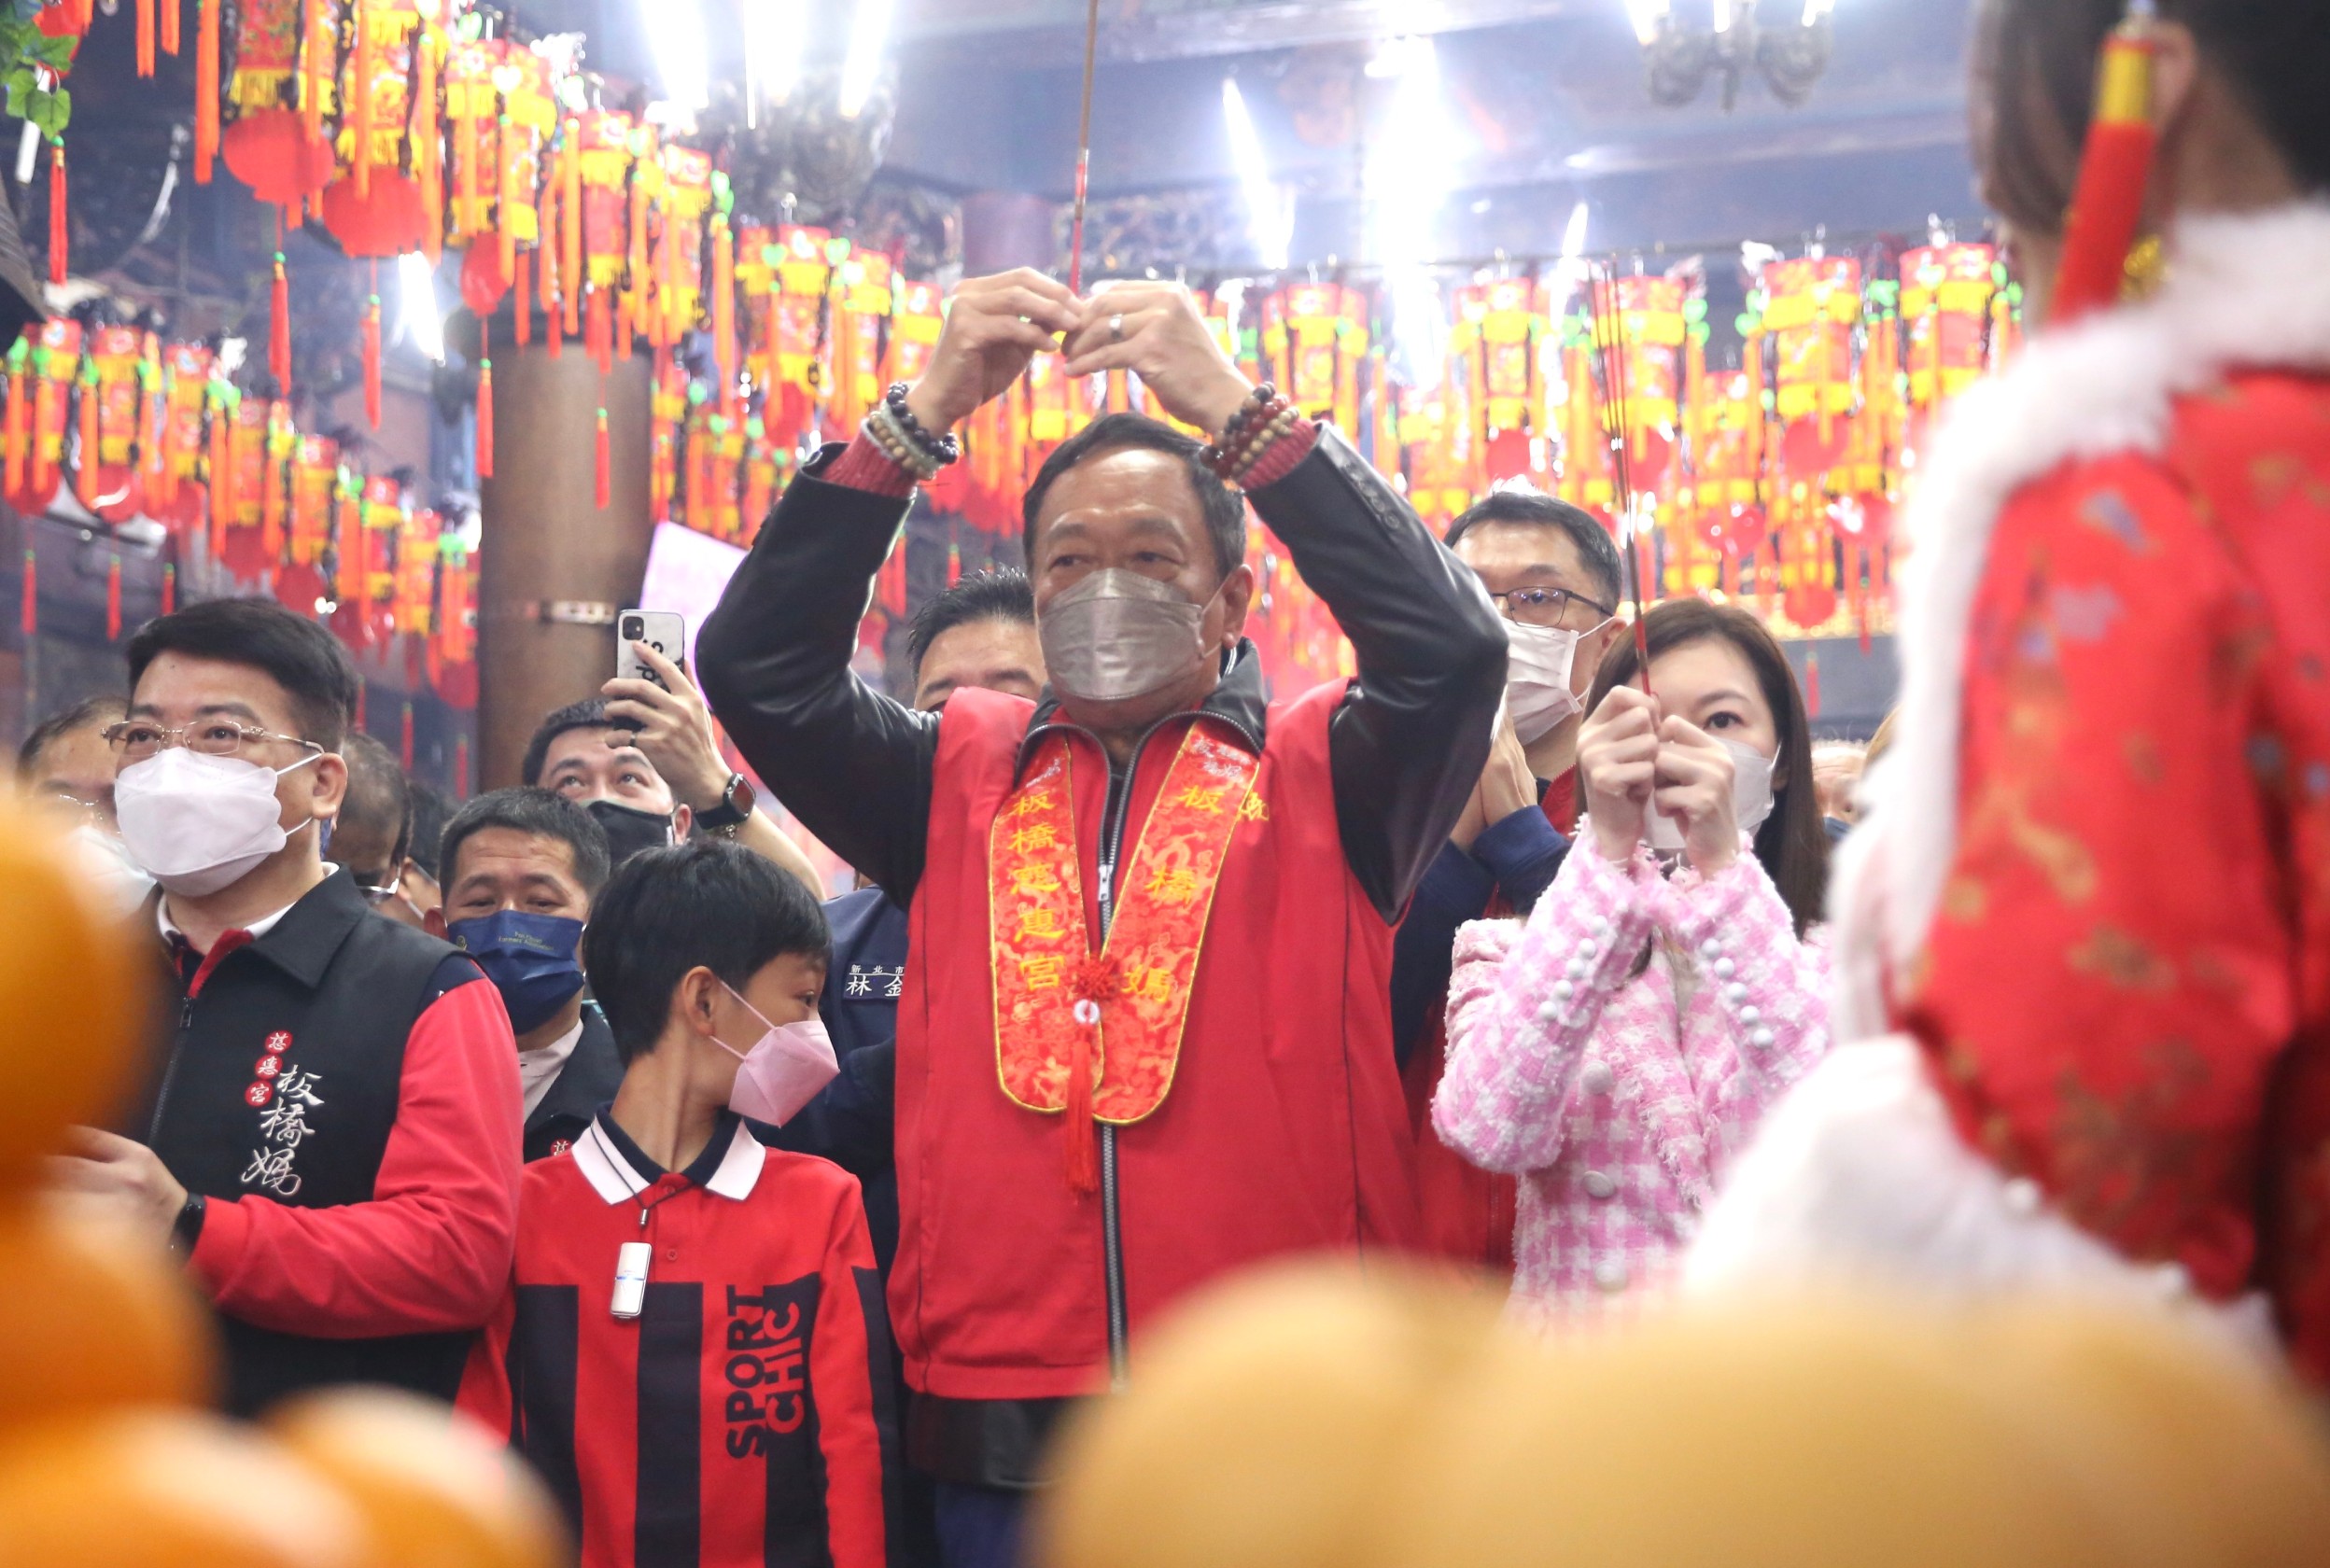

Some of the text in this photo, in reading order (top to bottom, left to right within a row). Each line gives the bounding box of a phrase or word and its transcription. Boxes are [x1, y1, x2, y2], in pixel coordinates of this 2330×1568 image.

[1006, 790, 1066, 992] 板橋慈惠宮
[1121, 785, 1225, 1004] 板橋媽
[846, 975, 903, 997] 林金
[850, 964, 905, 974] 新北市
[241, 1064, 325, 1196] 板橋媽
[248, 1031, 290, 1104] 慈惠宮
[725, 1284, 767, 1459] SPORT
[762, 1302, 805, 1435] CHIC
